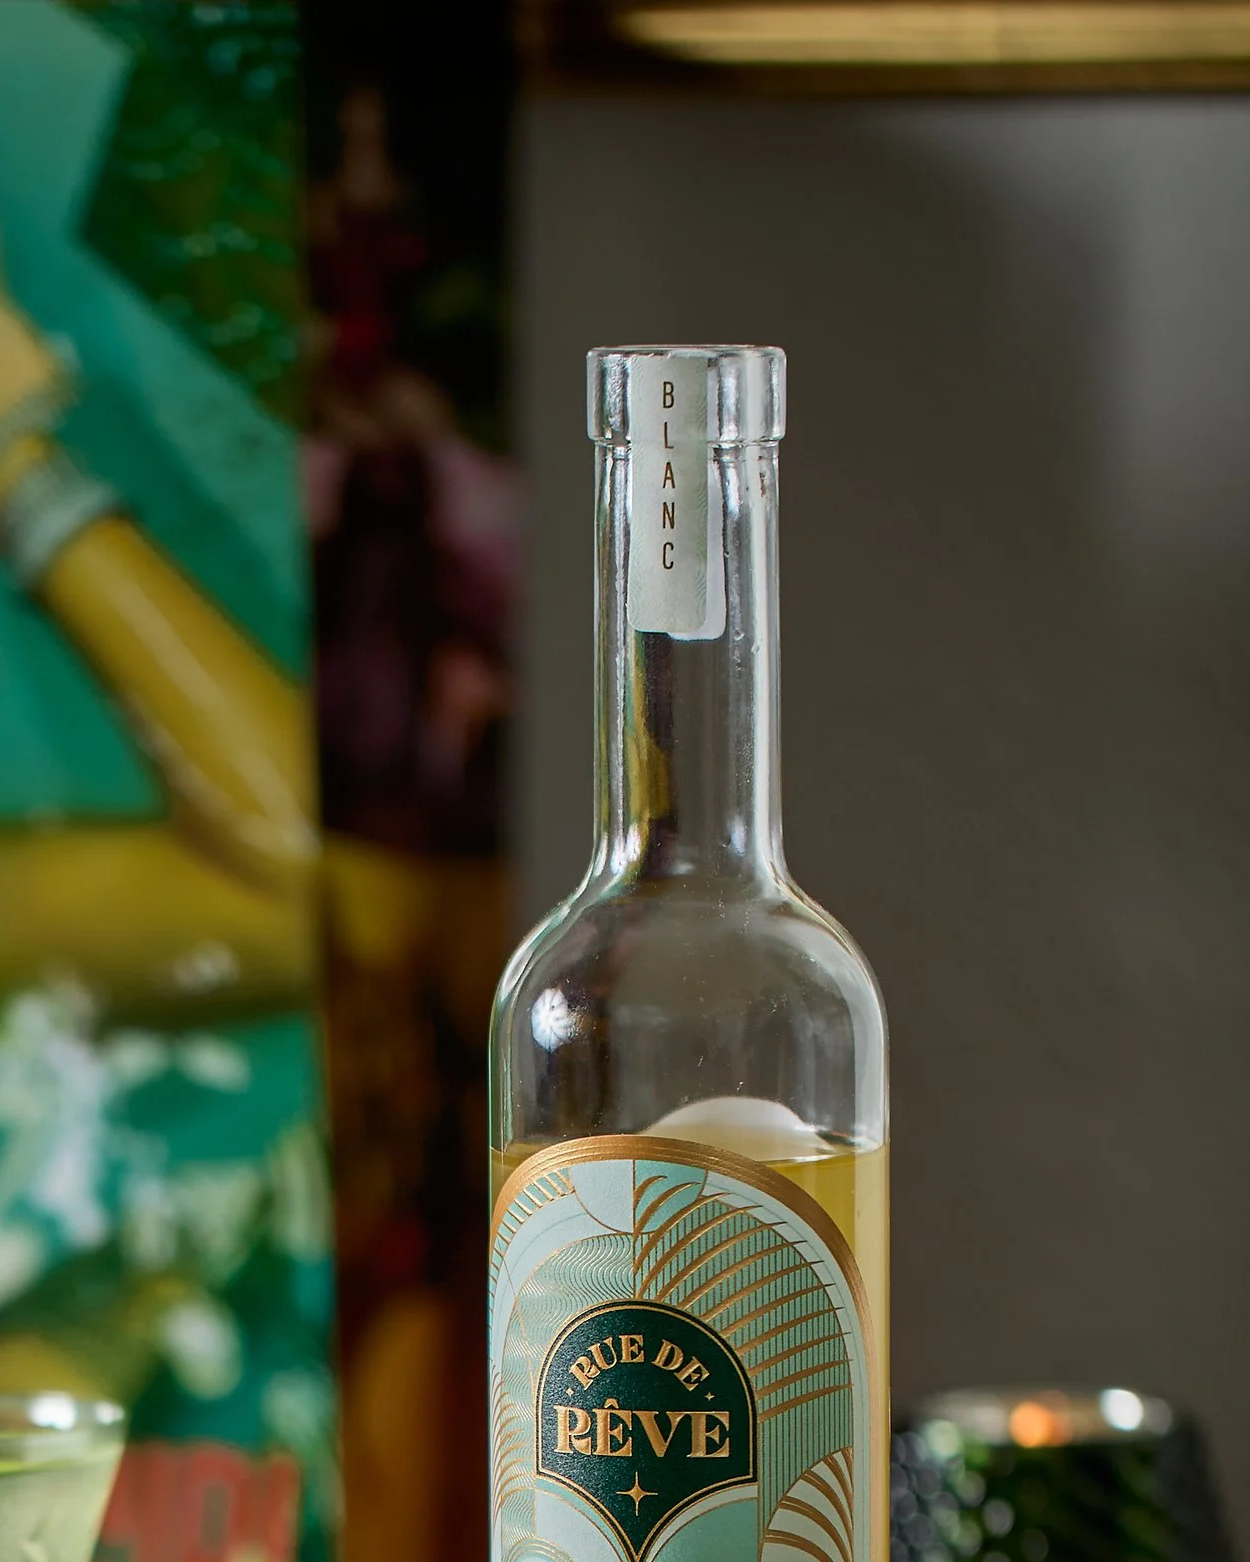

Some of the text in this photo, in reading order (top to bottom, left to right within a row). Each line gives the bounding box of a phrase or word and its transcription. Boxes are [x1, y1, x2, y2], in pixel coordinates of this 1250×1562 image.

[661, 380, 676, 570] BLANC
[568, 1333, 711, 1392] RUE DE
[553, 1397, 731, 1458] RÊVE
